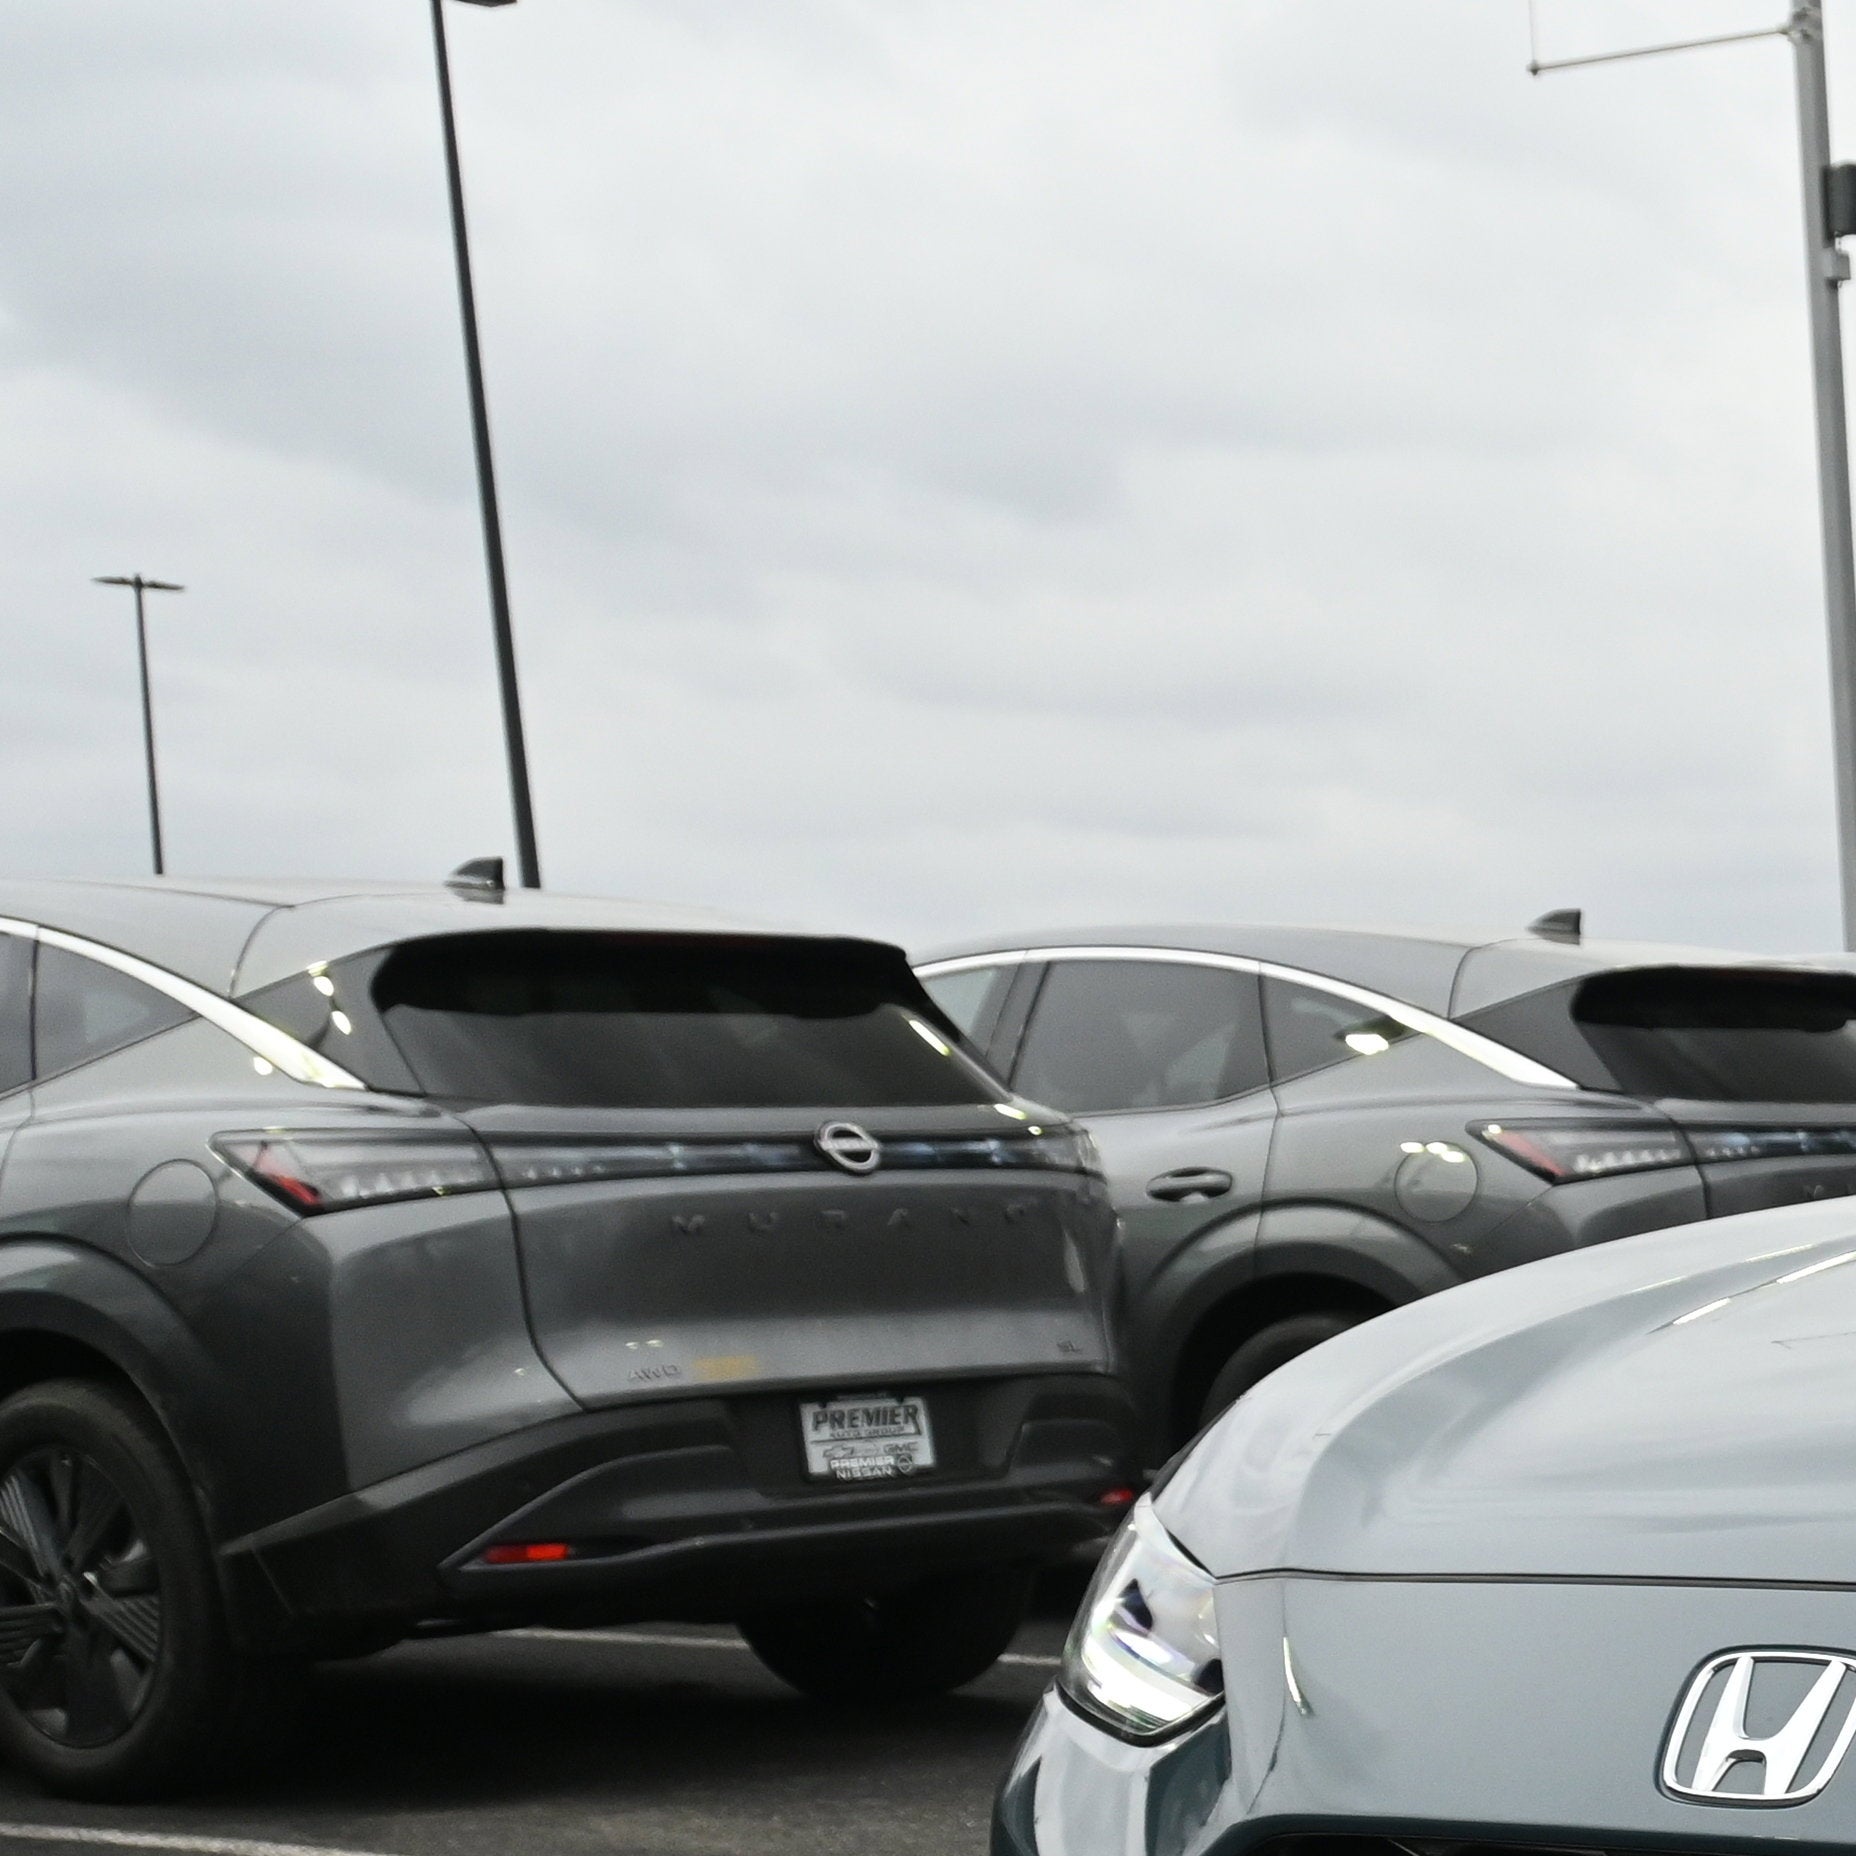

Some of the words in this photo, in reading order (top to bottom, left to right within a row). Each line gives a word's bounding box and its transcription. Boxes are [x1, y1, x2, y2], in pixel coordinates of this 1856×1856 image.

[812, 1404, 921, 1435] PREMIER
[830, 1456, 895, 1469] PREMIER
[836, 1466, 893, 1479] NISSAN
